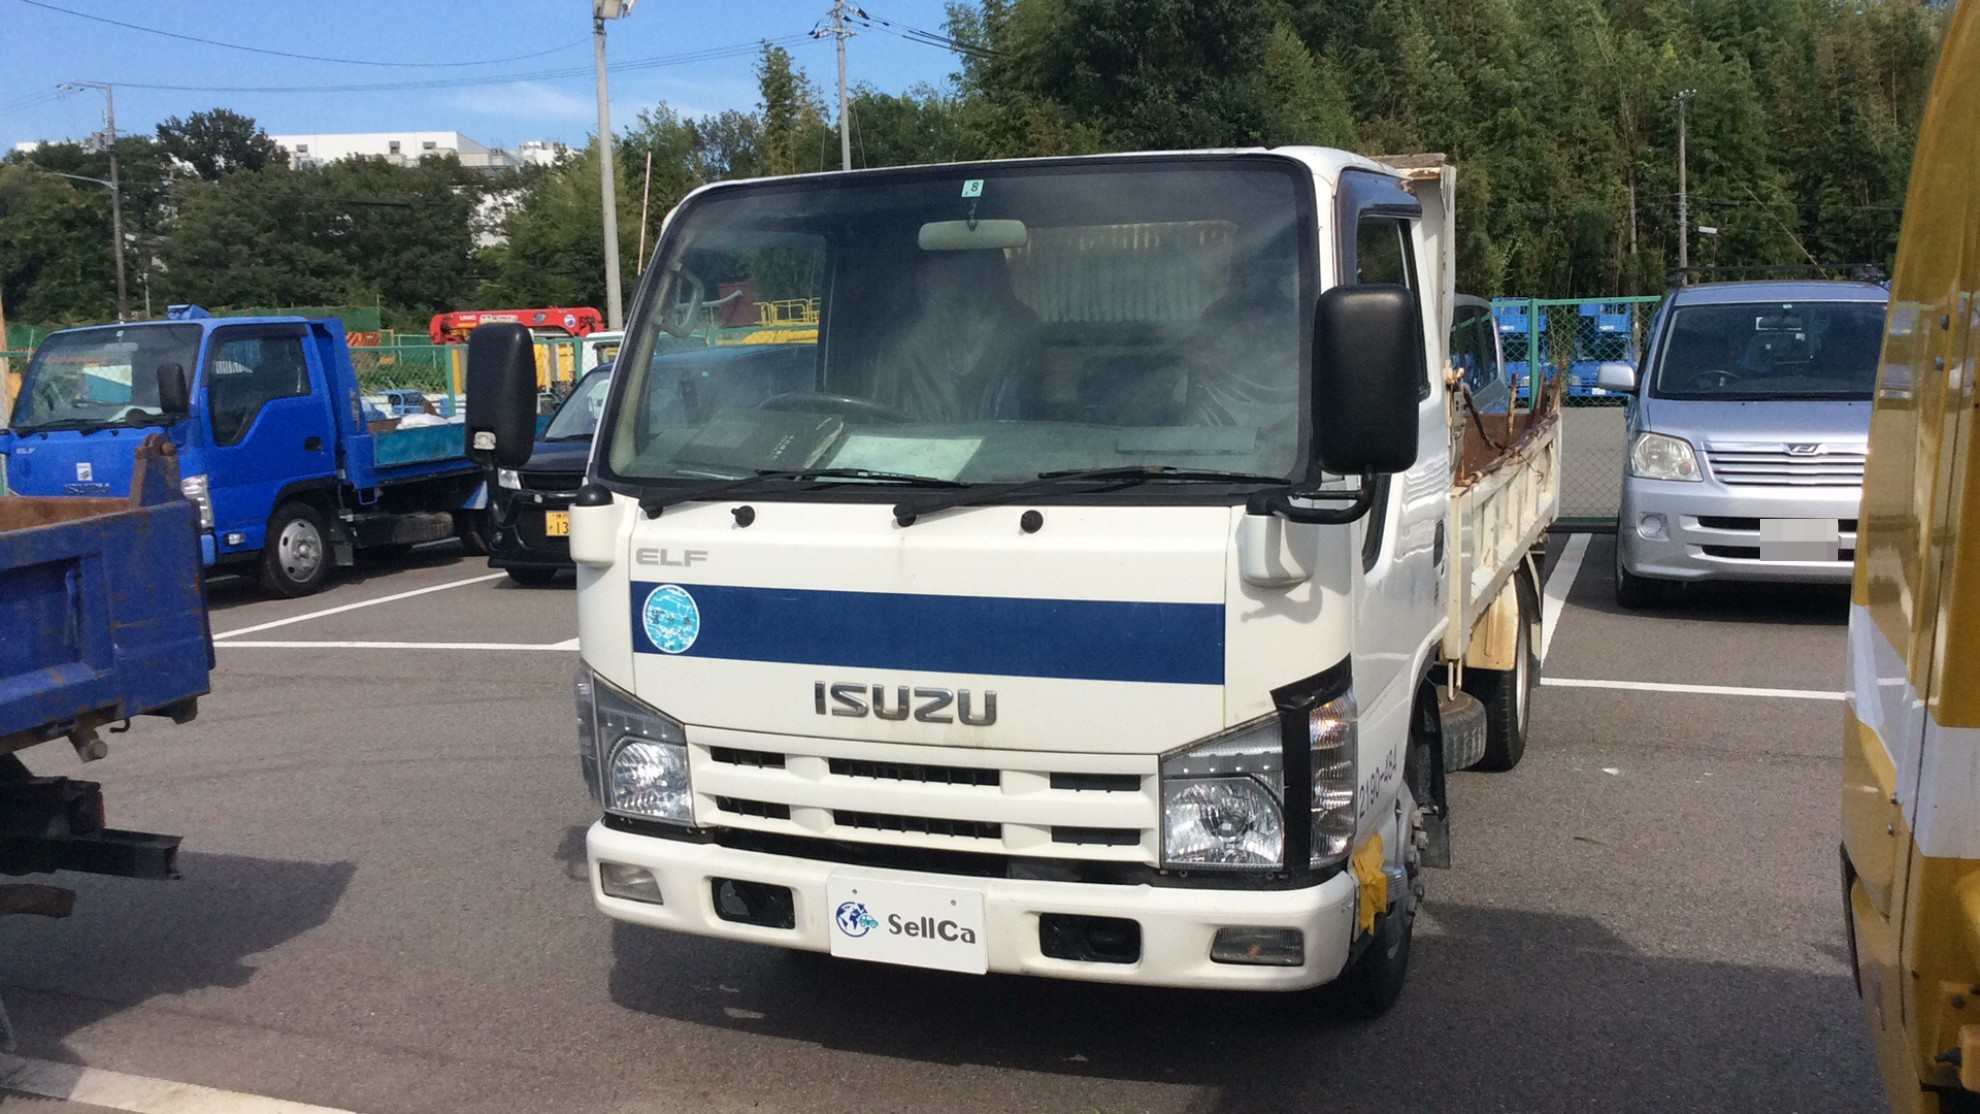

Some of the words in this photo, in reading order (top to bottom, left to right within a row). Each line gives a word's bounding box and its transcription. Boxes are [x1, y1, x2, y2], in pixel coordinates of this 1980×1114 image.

[971, 181, 980, 192] 8
[636, 547, 709, 568] ELF
[814, 680, 997, 726] ISUZU
[887, 913, 976, 944] SellCa
